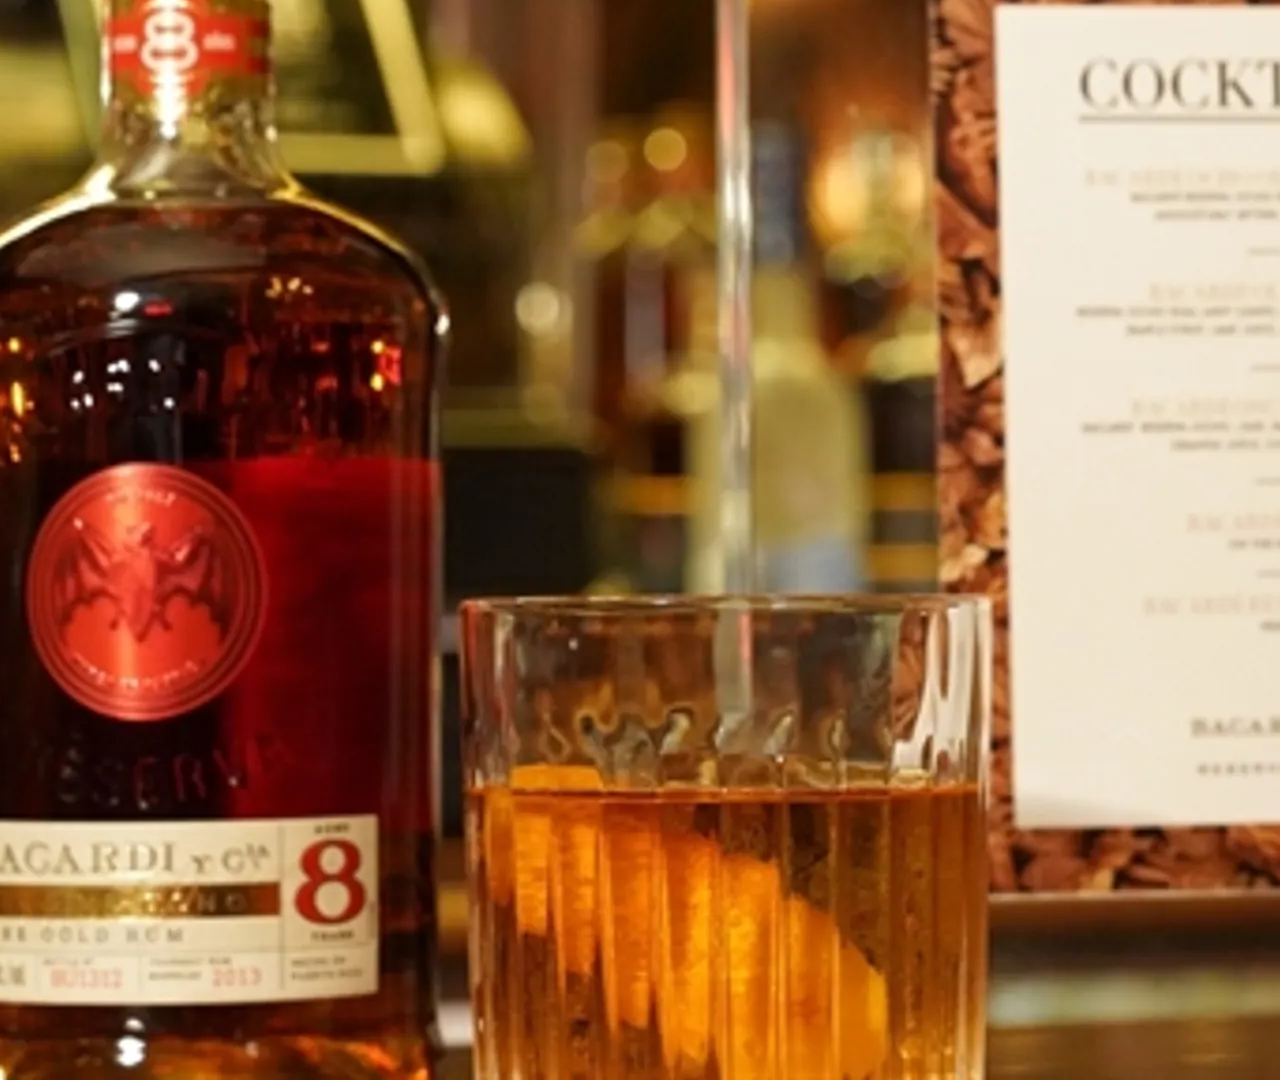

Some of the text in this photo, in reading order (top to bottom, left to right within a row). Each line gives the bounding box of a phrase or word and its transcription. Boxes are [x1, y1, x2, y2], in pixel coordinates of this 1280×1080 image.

[140, 9, 200, 72] 8
[293, 837, 368, 927] 8
[40, 925, 110, 943] GOLD
[126, 925, 184, 943] RUM
